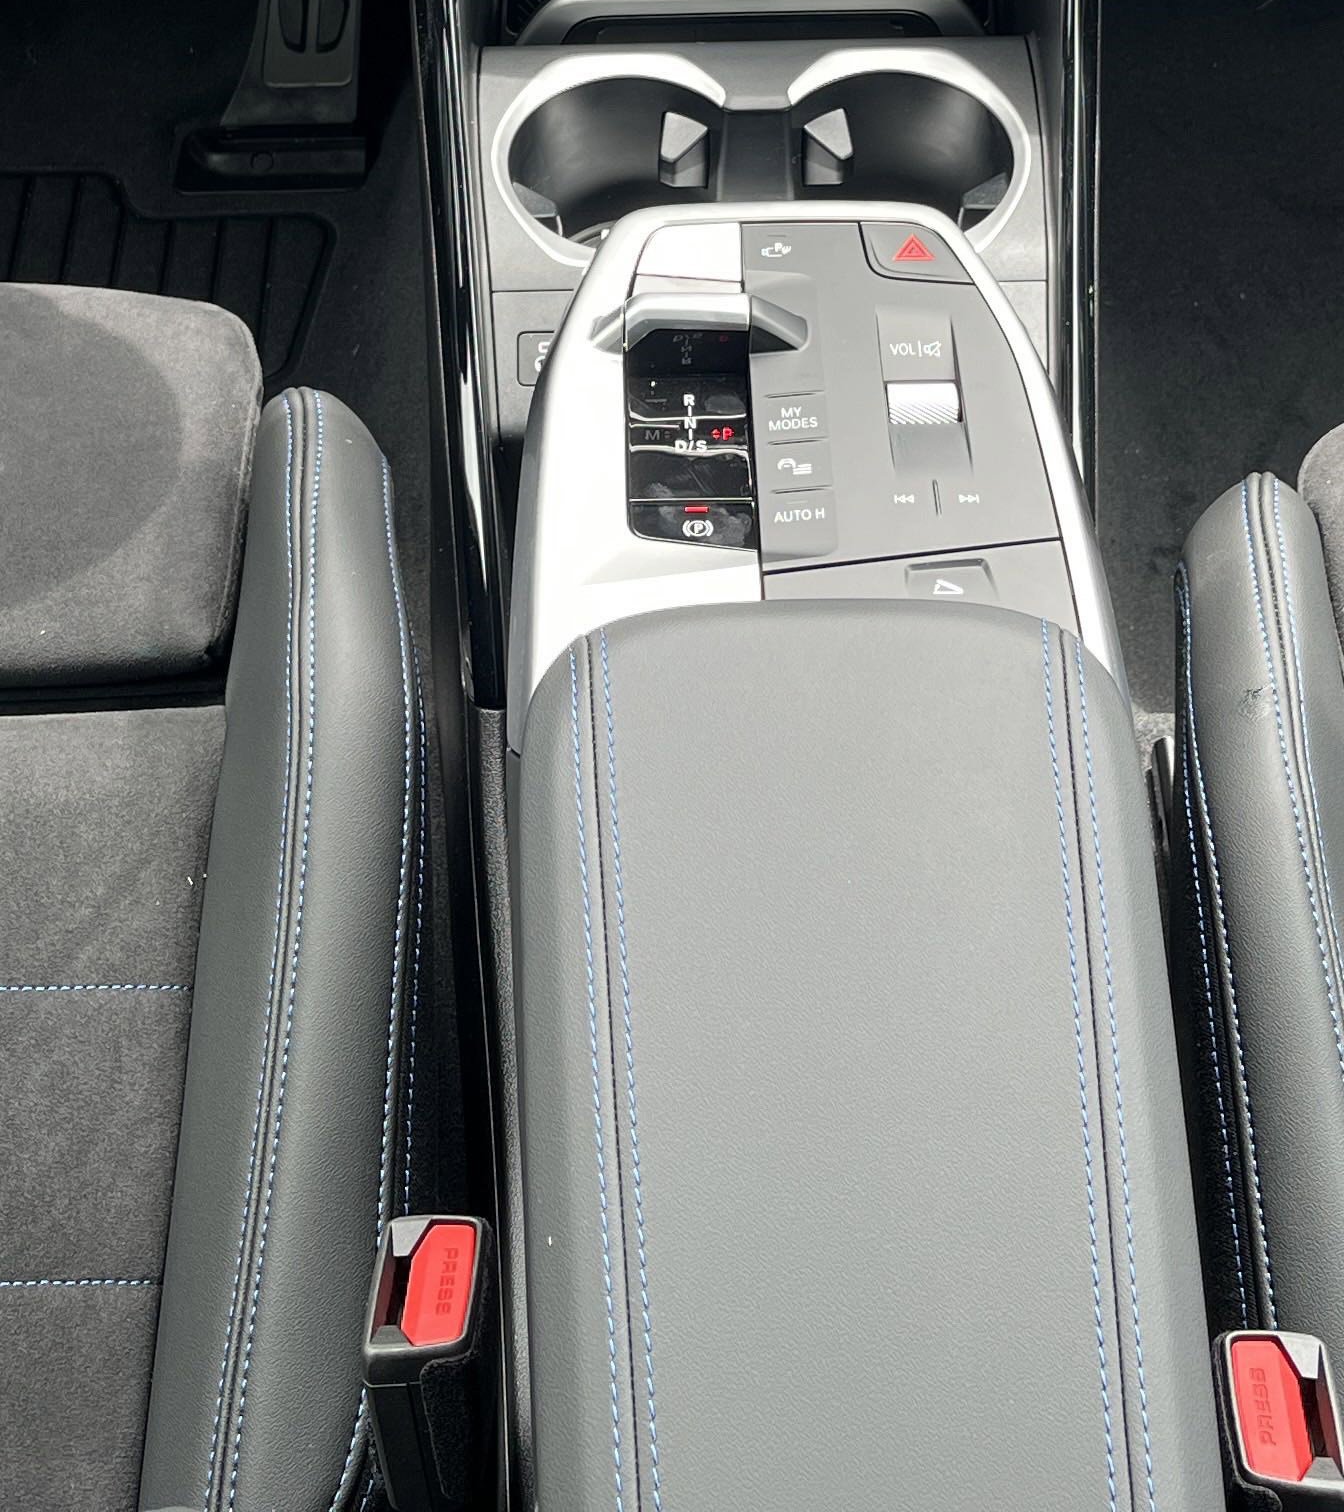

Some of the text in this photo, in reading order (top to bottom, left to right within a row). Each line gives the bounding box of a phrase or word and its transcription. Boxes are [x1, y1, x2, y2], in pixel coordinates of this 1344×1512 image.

[889, 343, 916, 356] VOL
[683, 394, 695, 406] R
[780, 406, 803, 419] MY
[684, 416, 696, 429] N
[768, 417, 818, 431] MODES
[645, 429, 660, 440] M
[722, 427, 733, 440] P
[675, 440, 708, 453] D/S
[774, 508, 825, 524] AUTO H
[436, 1247, 459, 1316] PRESS
[1249, 1367, 1277, 1447] PRESS
